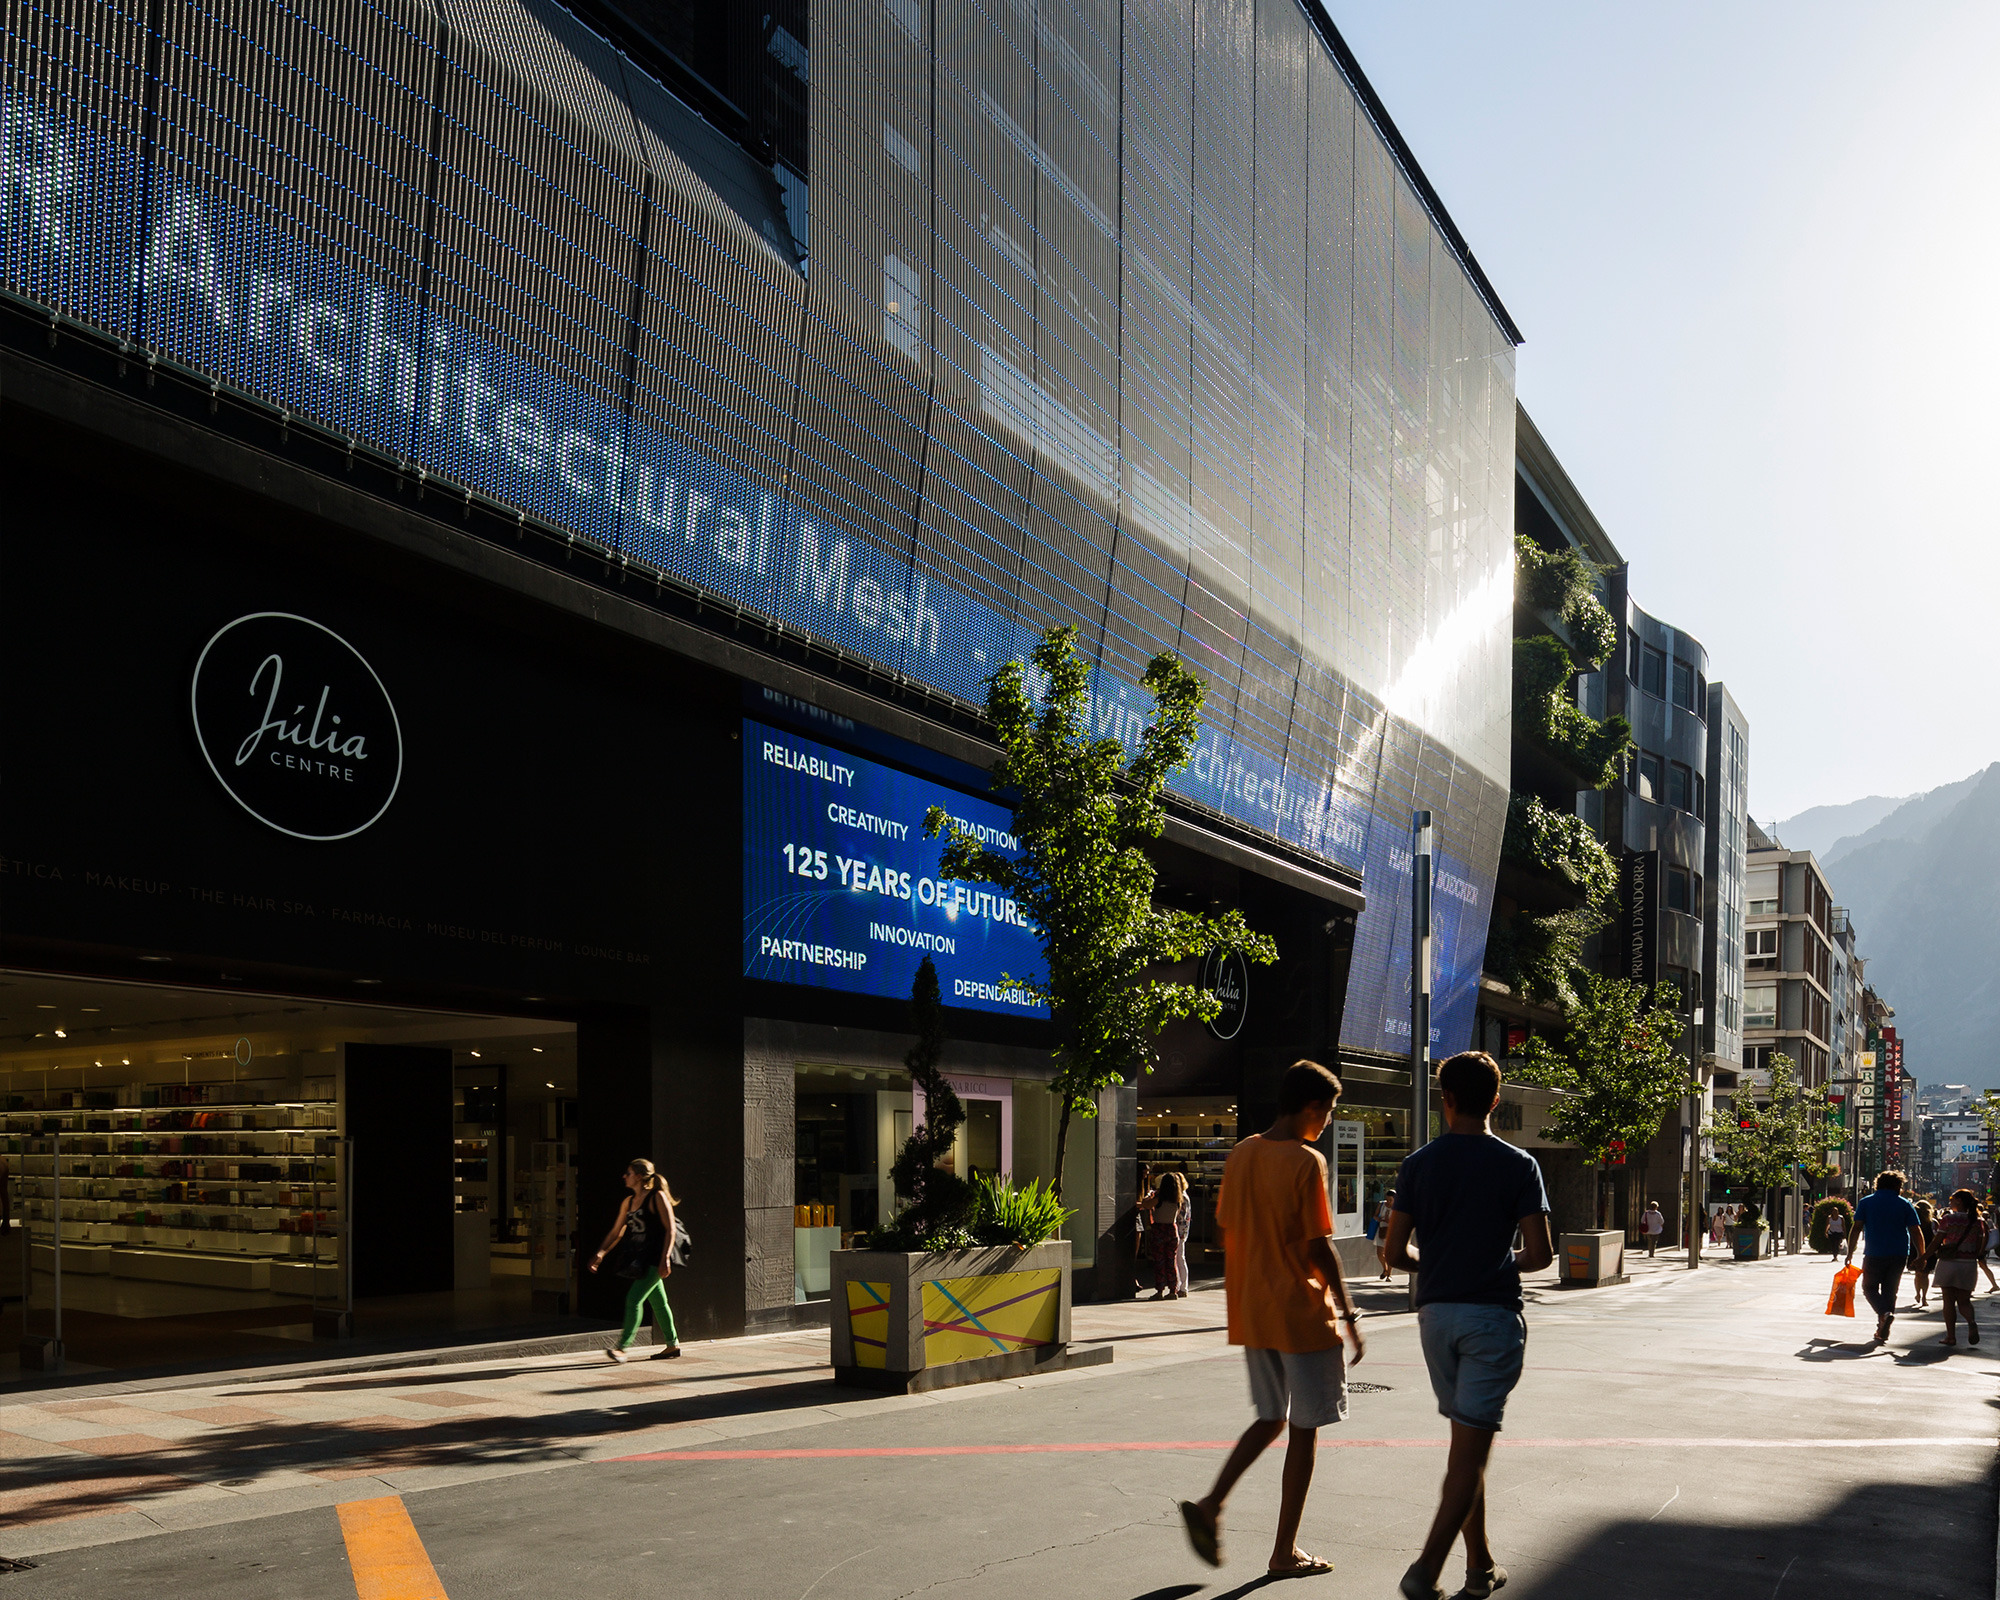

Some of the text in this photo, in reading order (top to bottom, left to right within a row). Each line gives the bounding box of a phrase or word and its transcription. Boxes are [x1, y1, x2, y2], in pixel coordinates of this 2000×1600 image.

[132, 188, 770, 577] Architectural
[794, 520, 940, 657] Mesh
[235, 654, 368, 766] Júlia
[270, 752, 354, 782] CENTRE
[763, 741, 855, 787] RELIABILITY
[827, 803, 909, 841] CREATIVITY
[953, 816, 1018, 851] TRADITION
[783, 843, 1028, 928] 125 YEARS OF FUTURE
[86, 871, 171, 895] MAKEUP
[190, 886, 226, 905] THE
[233, 893, 277, 911] HAIR
[281, 900, 316, 917] SPA
[331, 907, 413, 931] FARMÀCIA
[426, 921, 475, 941] MUSEU
[481, 930, 507, 945] DEL
[511, 935, 563, 952] PERFUM
[574, 944, 624, 961] LOUNGE
[627, 951, 650, 964] BAR
[869, 922, 956, 956] INNOVATION
[761, 935, 868, 971] PARTNERSHIP
[1632, 930, 1645, 978] PRIVADA
